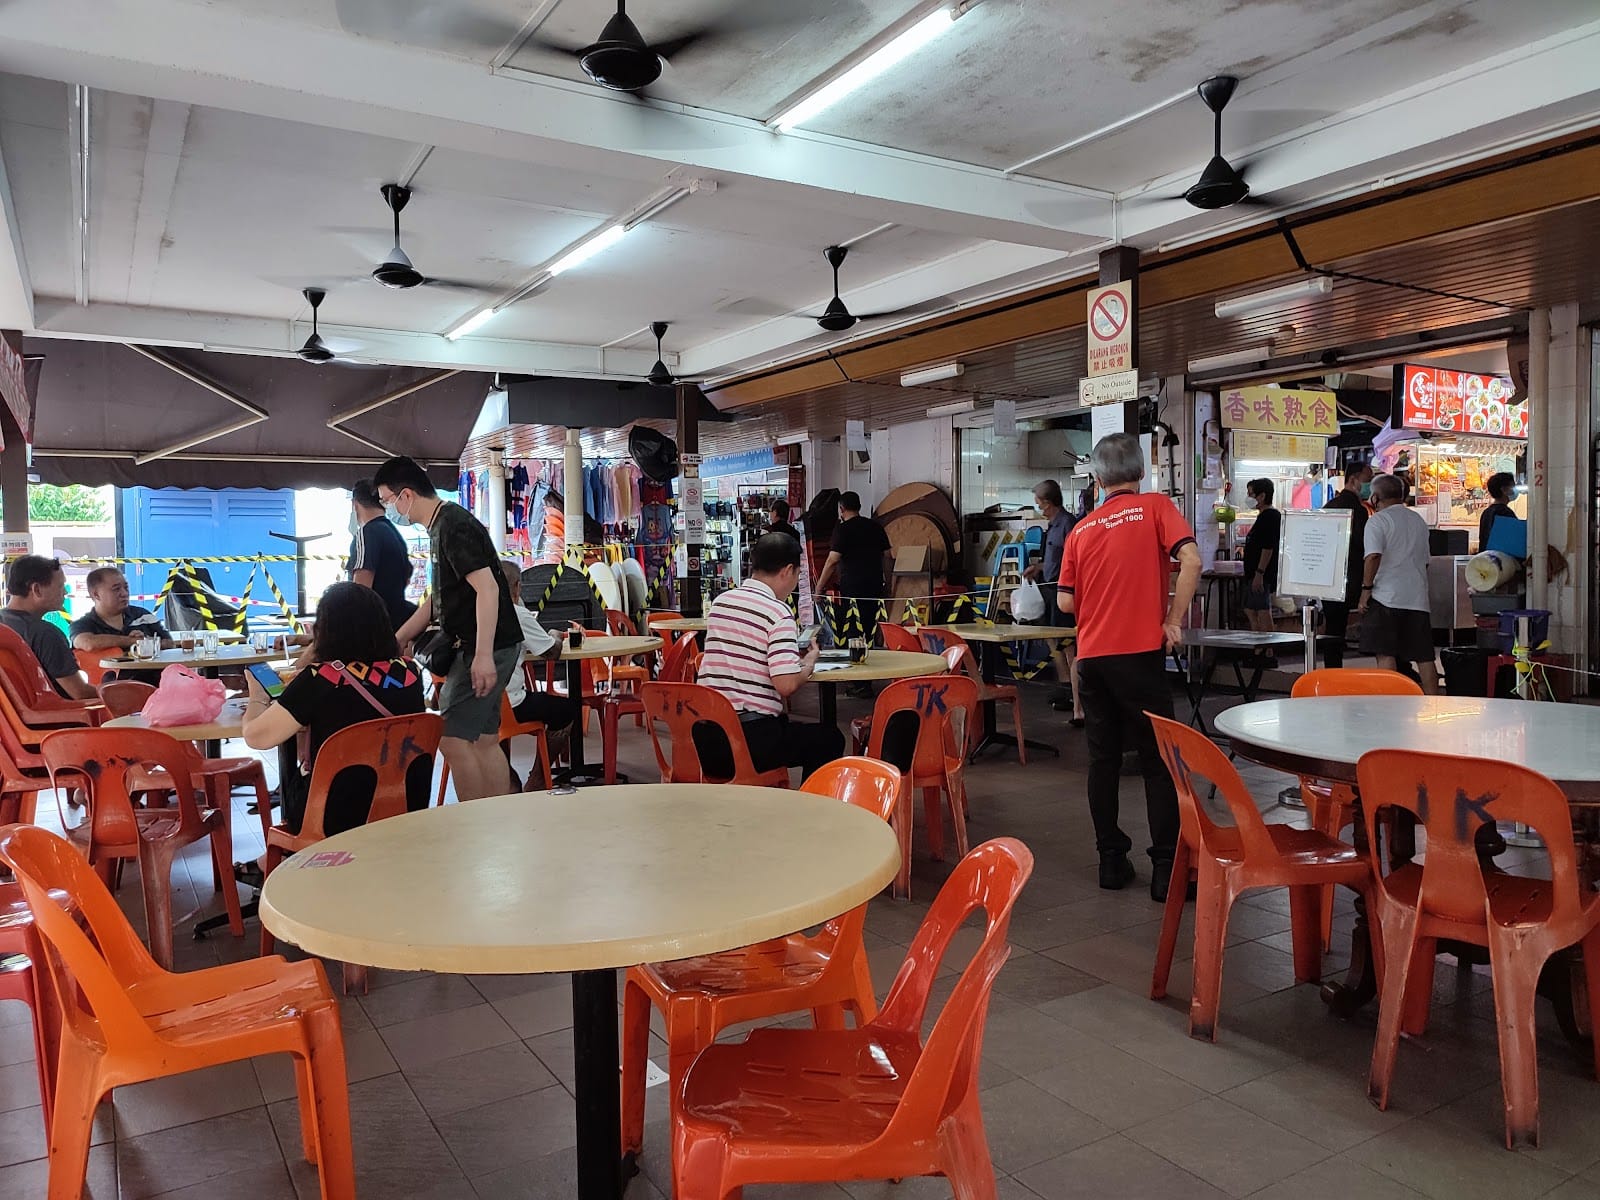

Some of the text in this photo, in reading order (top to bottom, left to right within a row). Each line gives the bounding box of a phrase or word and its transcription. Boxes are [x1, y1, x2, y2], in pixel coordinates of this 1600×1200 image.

[1111, 379, 1131, 387] Outside
[1114, 389, 1134, 399] allowed
[1224, 391, 1334, 428] 香味熟食
[1125, 514, 1143, 522] 1900
[909, 683, 950, 716] TK
